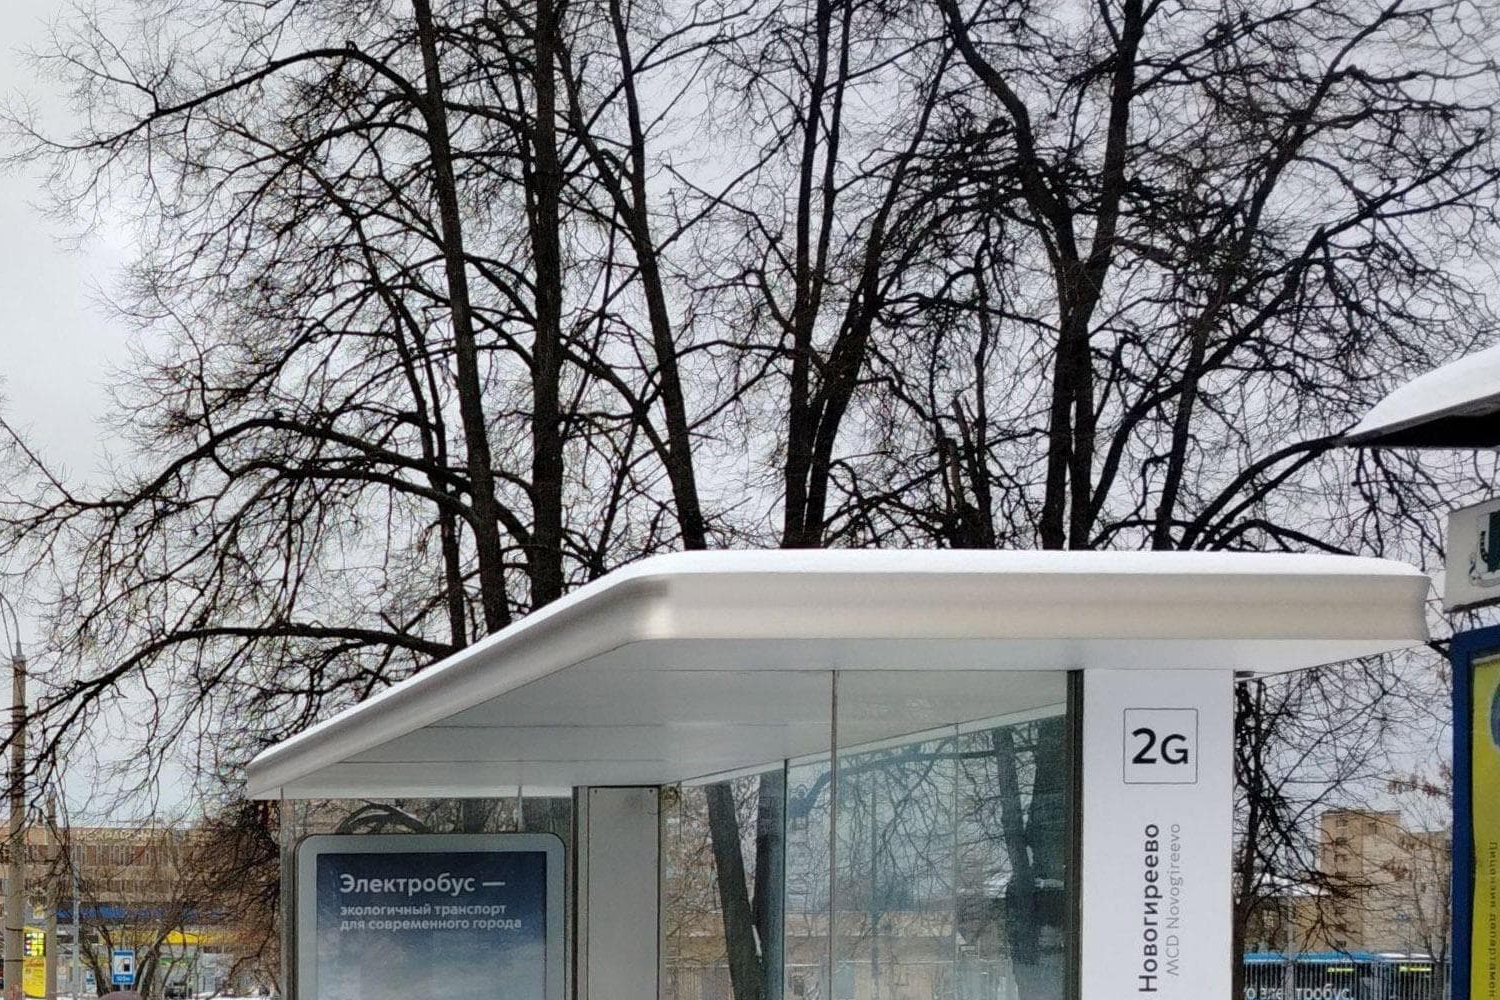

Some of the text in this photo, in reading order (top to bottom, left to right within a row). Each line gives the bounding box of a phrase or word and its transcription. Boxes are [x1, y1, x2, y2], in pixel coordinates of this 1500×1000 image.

[1131, 727, 1190, 765] 2G
[339, 872, 476, 897] Электробус
[1165, 823, 1184, 977] MCD Novogireevo
[339, 903, 507, 917] экологичный транспорт
[1138, 823, 1163, 993] Новогиреево
[339, 918, 522, 932] для современного города
